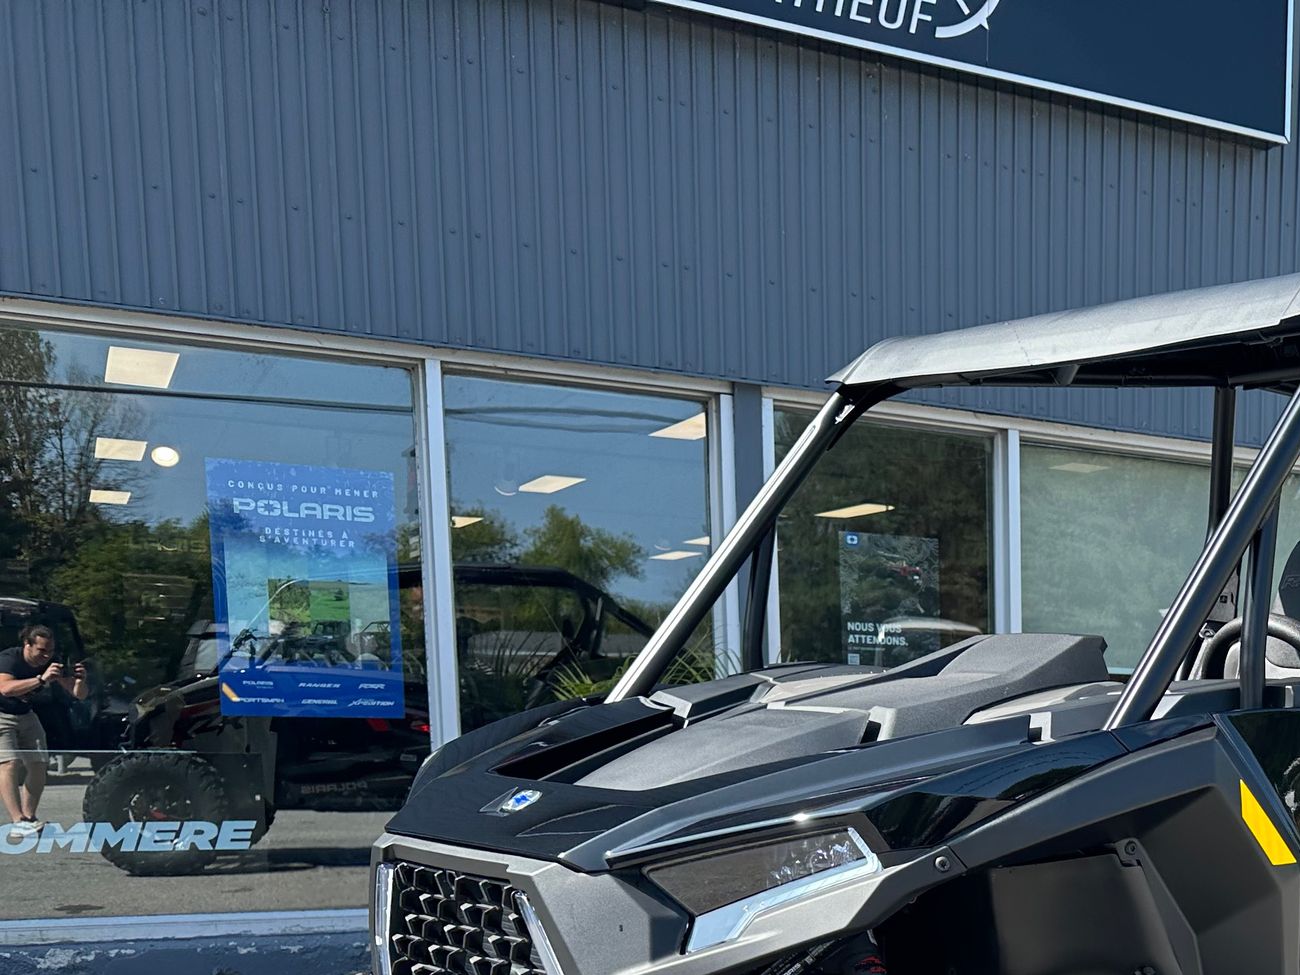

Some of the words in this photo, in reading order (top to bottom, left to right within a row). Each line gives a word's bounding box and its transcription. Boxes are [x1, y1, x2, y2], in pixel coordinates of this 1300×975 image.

[228, 480, 283, 492] CONÇUS
[291, 485, 326, 495] POUR
[334, 488, 379, 498] MENER
[233, 498, 375, 523] POLARIS
[259, 535, 355, 548] S'AVENTURER
[847, 621, 874, 632] NOUS
[876, 623, 902, 634] VOUS
